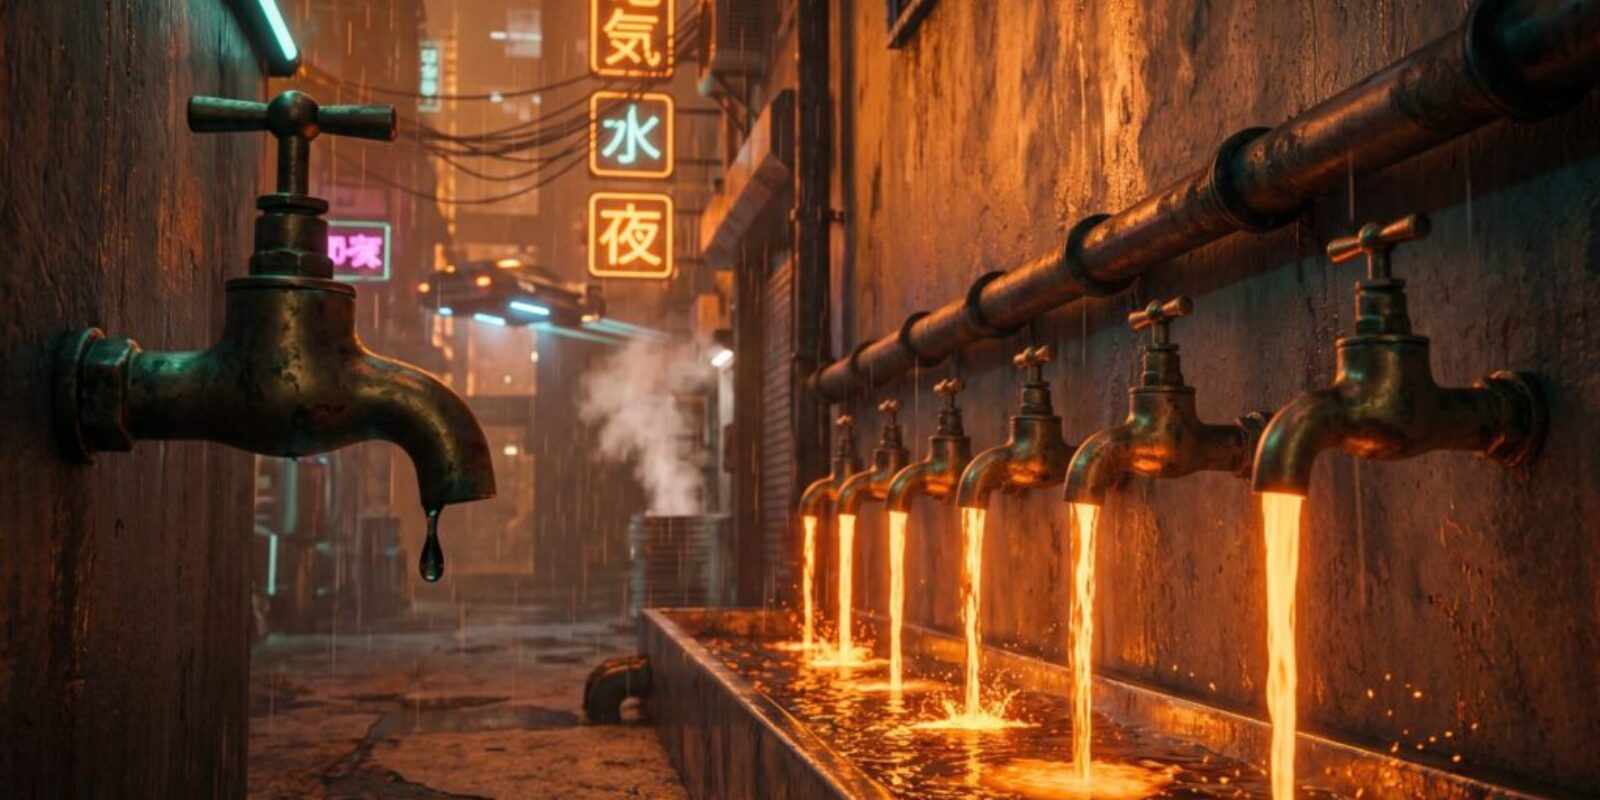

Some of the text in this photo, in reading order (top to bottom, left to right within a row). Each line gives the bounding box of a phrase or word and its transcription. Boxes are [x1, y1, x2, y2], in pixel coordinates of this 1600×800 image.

[603, 0, 661, 68] 気
[602, 103, 661, 164] 水
[599, 203, 662, 265] 夜
